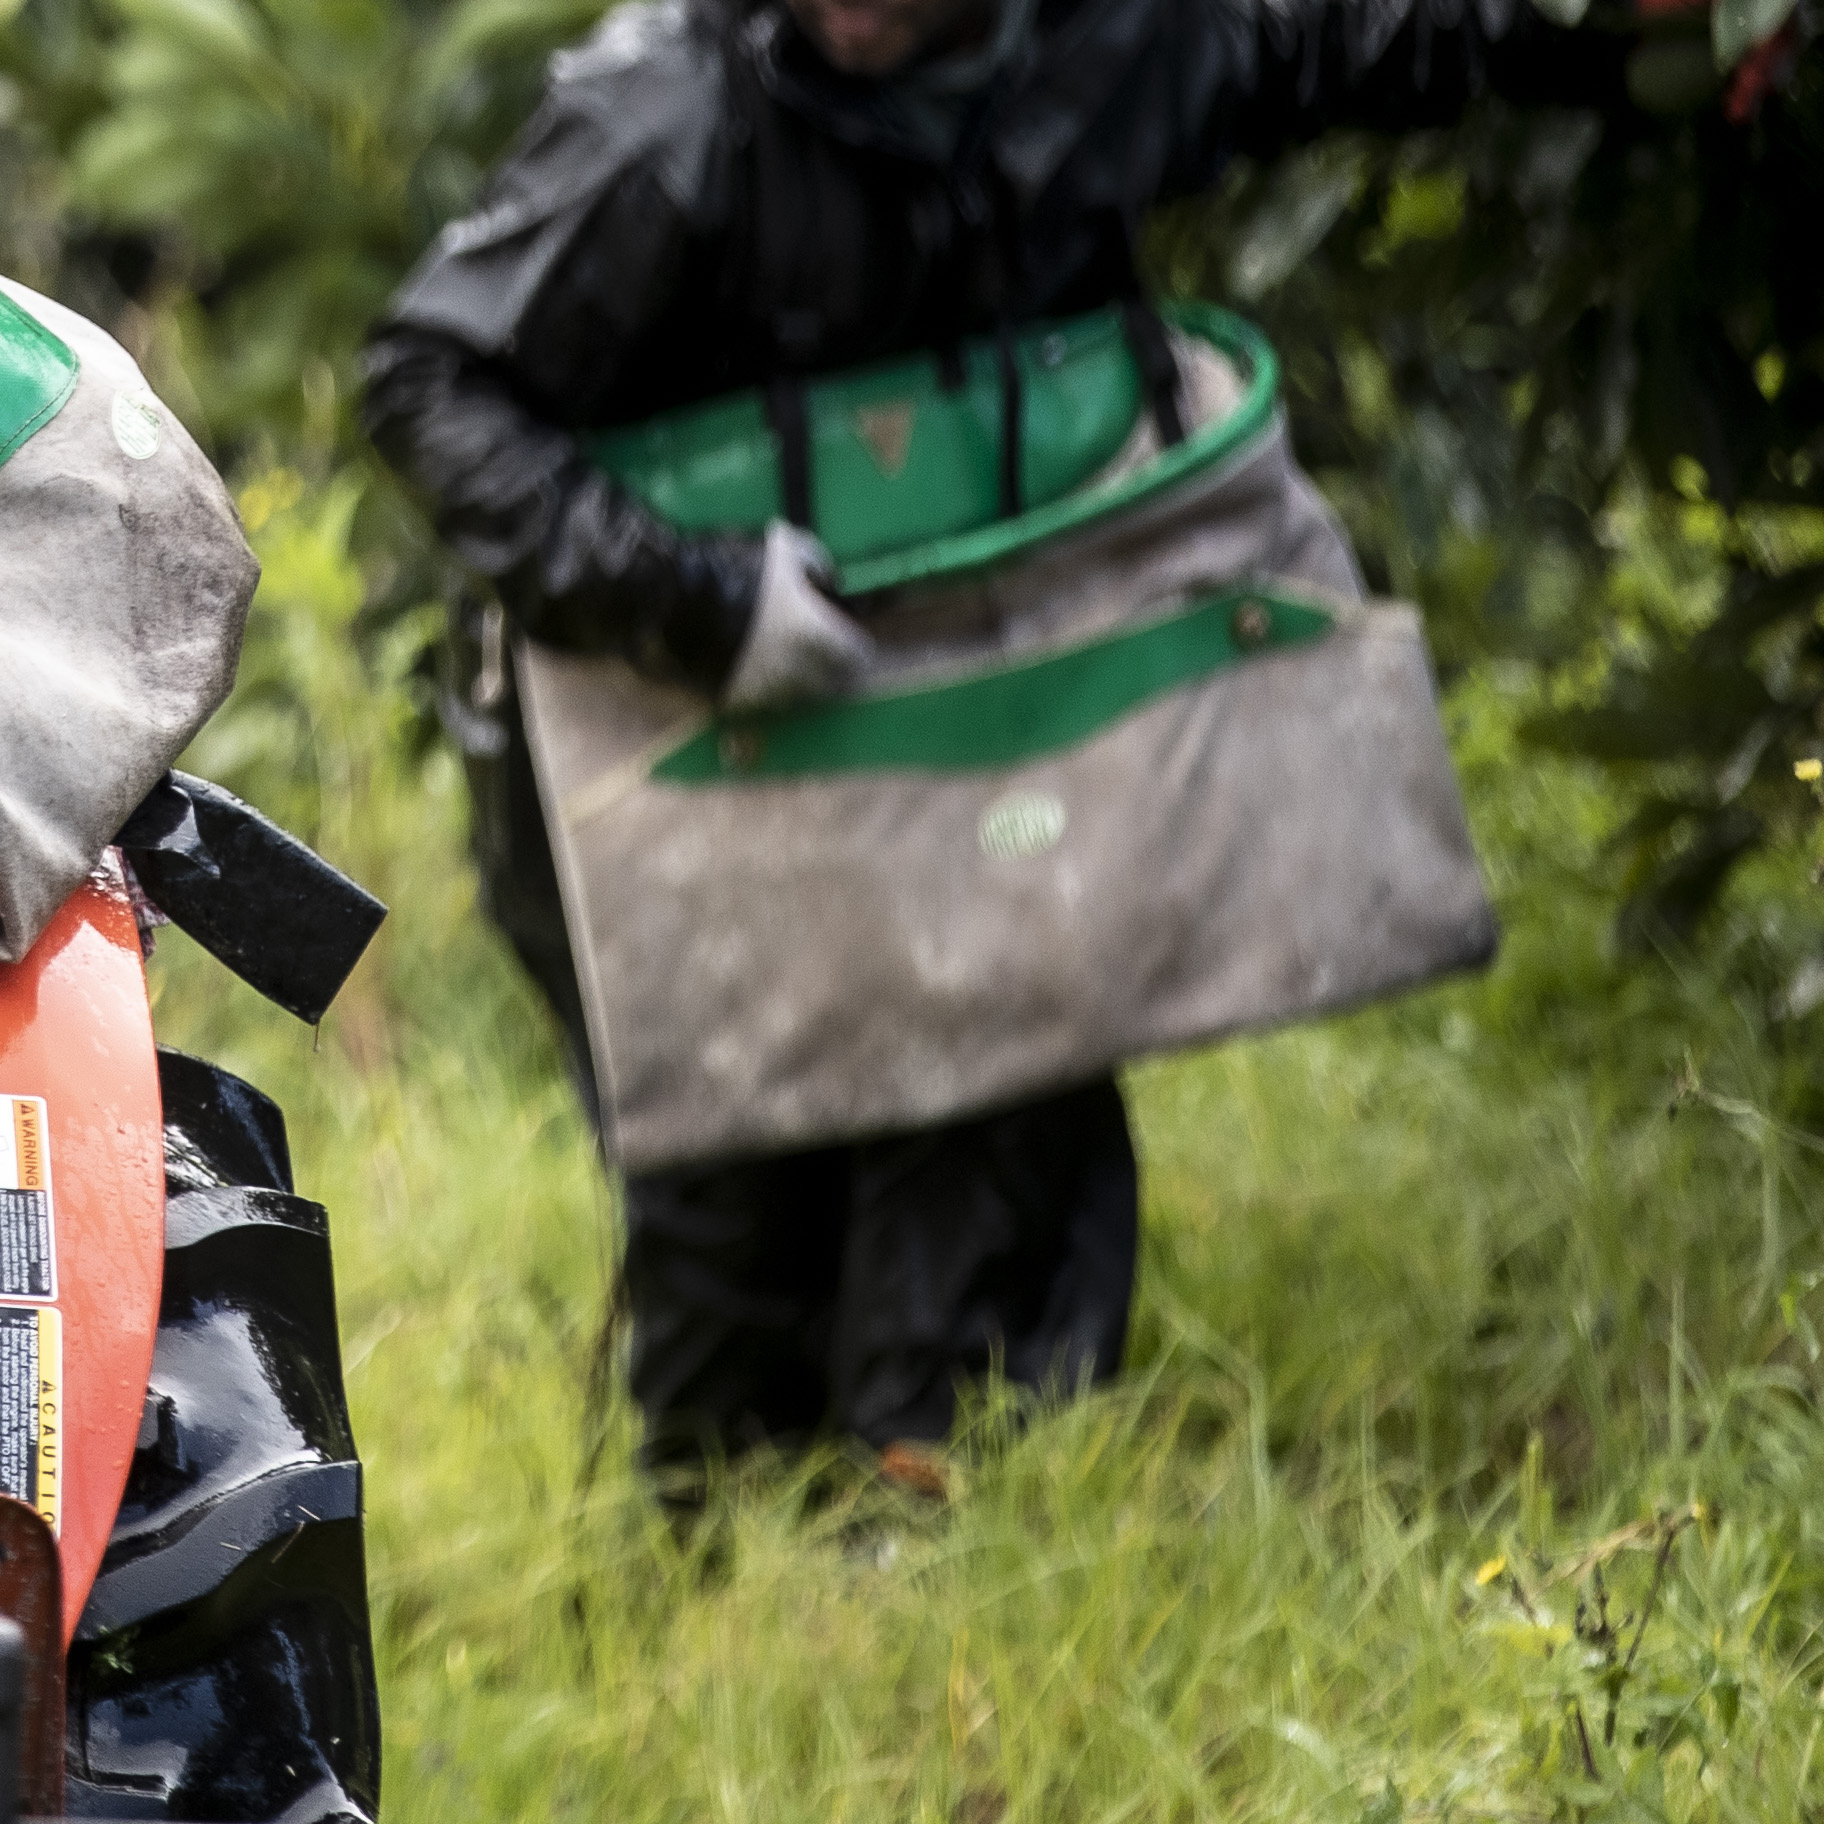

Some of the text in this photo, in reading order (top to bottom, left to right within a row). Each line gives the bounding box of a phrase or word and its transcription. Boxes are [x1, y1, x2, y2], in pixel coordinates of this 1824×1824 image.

[22, 1119, 39, 1186] WARNING
[29, 1329, 38, 1356] AVOID
[29, 1358, 38, 1406] PERSONAL
[29, 1408, 38, 1440] INJURY
[41, 1402, 56, 1524] CAUTIO
